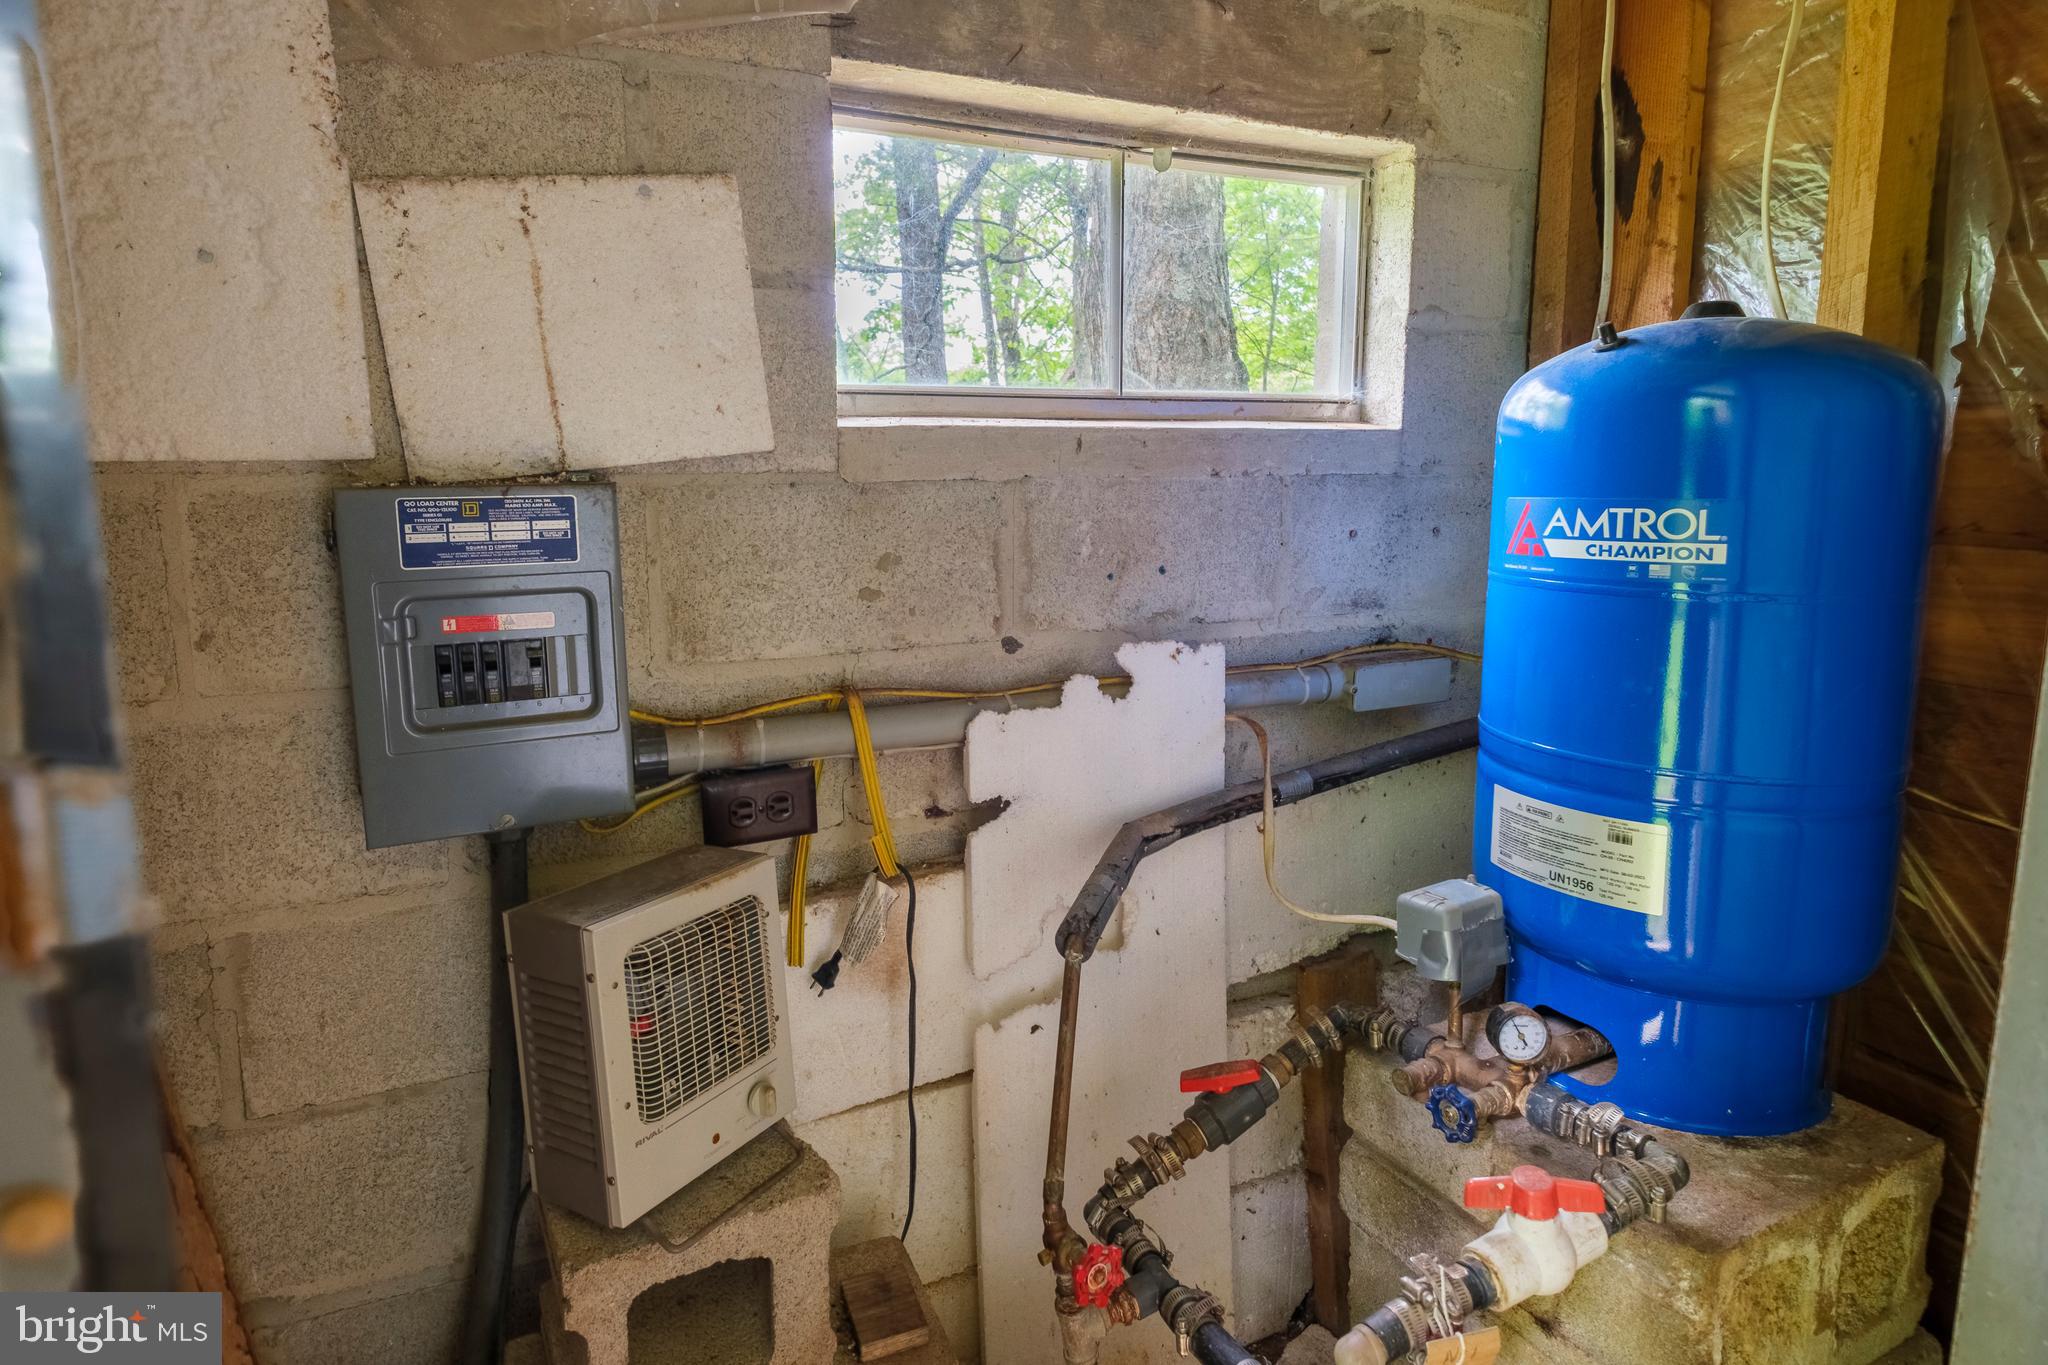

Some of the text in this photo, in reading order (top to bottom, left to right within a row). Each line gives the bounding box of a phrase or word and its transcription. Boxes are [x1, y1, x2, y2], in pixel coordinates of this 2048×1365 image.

[1543, 507, 1721, 541] AMTROL
[1585, 544, 1714, 561] CHAMPION
[1549, 870, 1594, 892] UN1956
[634, 1128, 663, 1148] RIVAL
